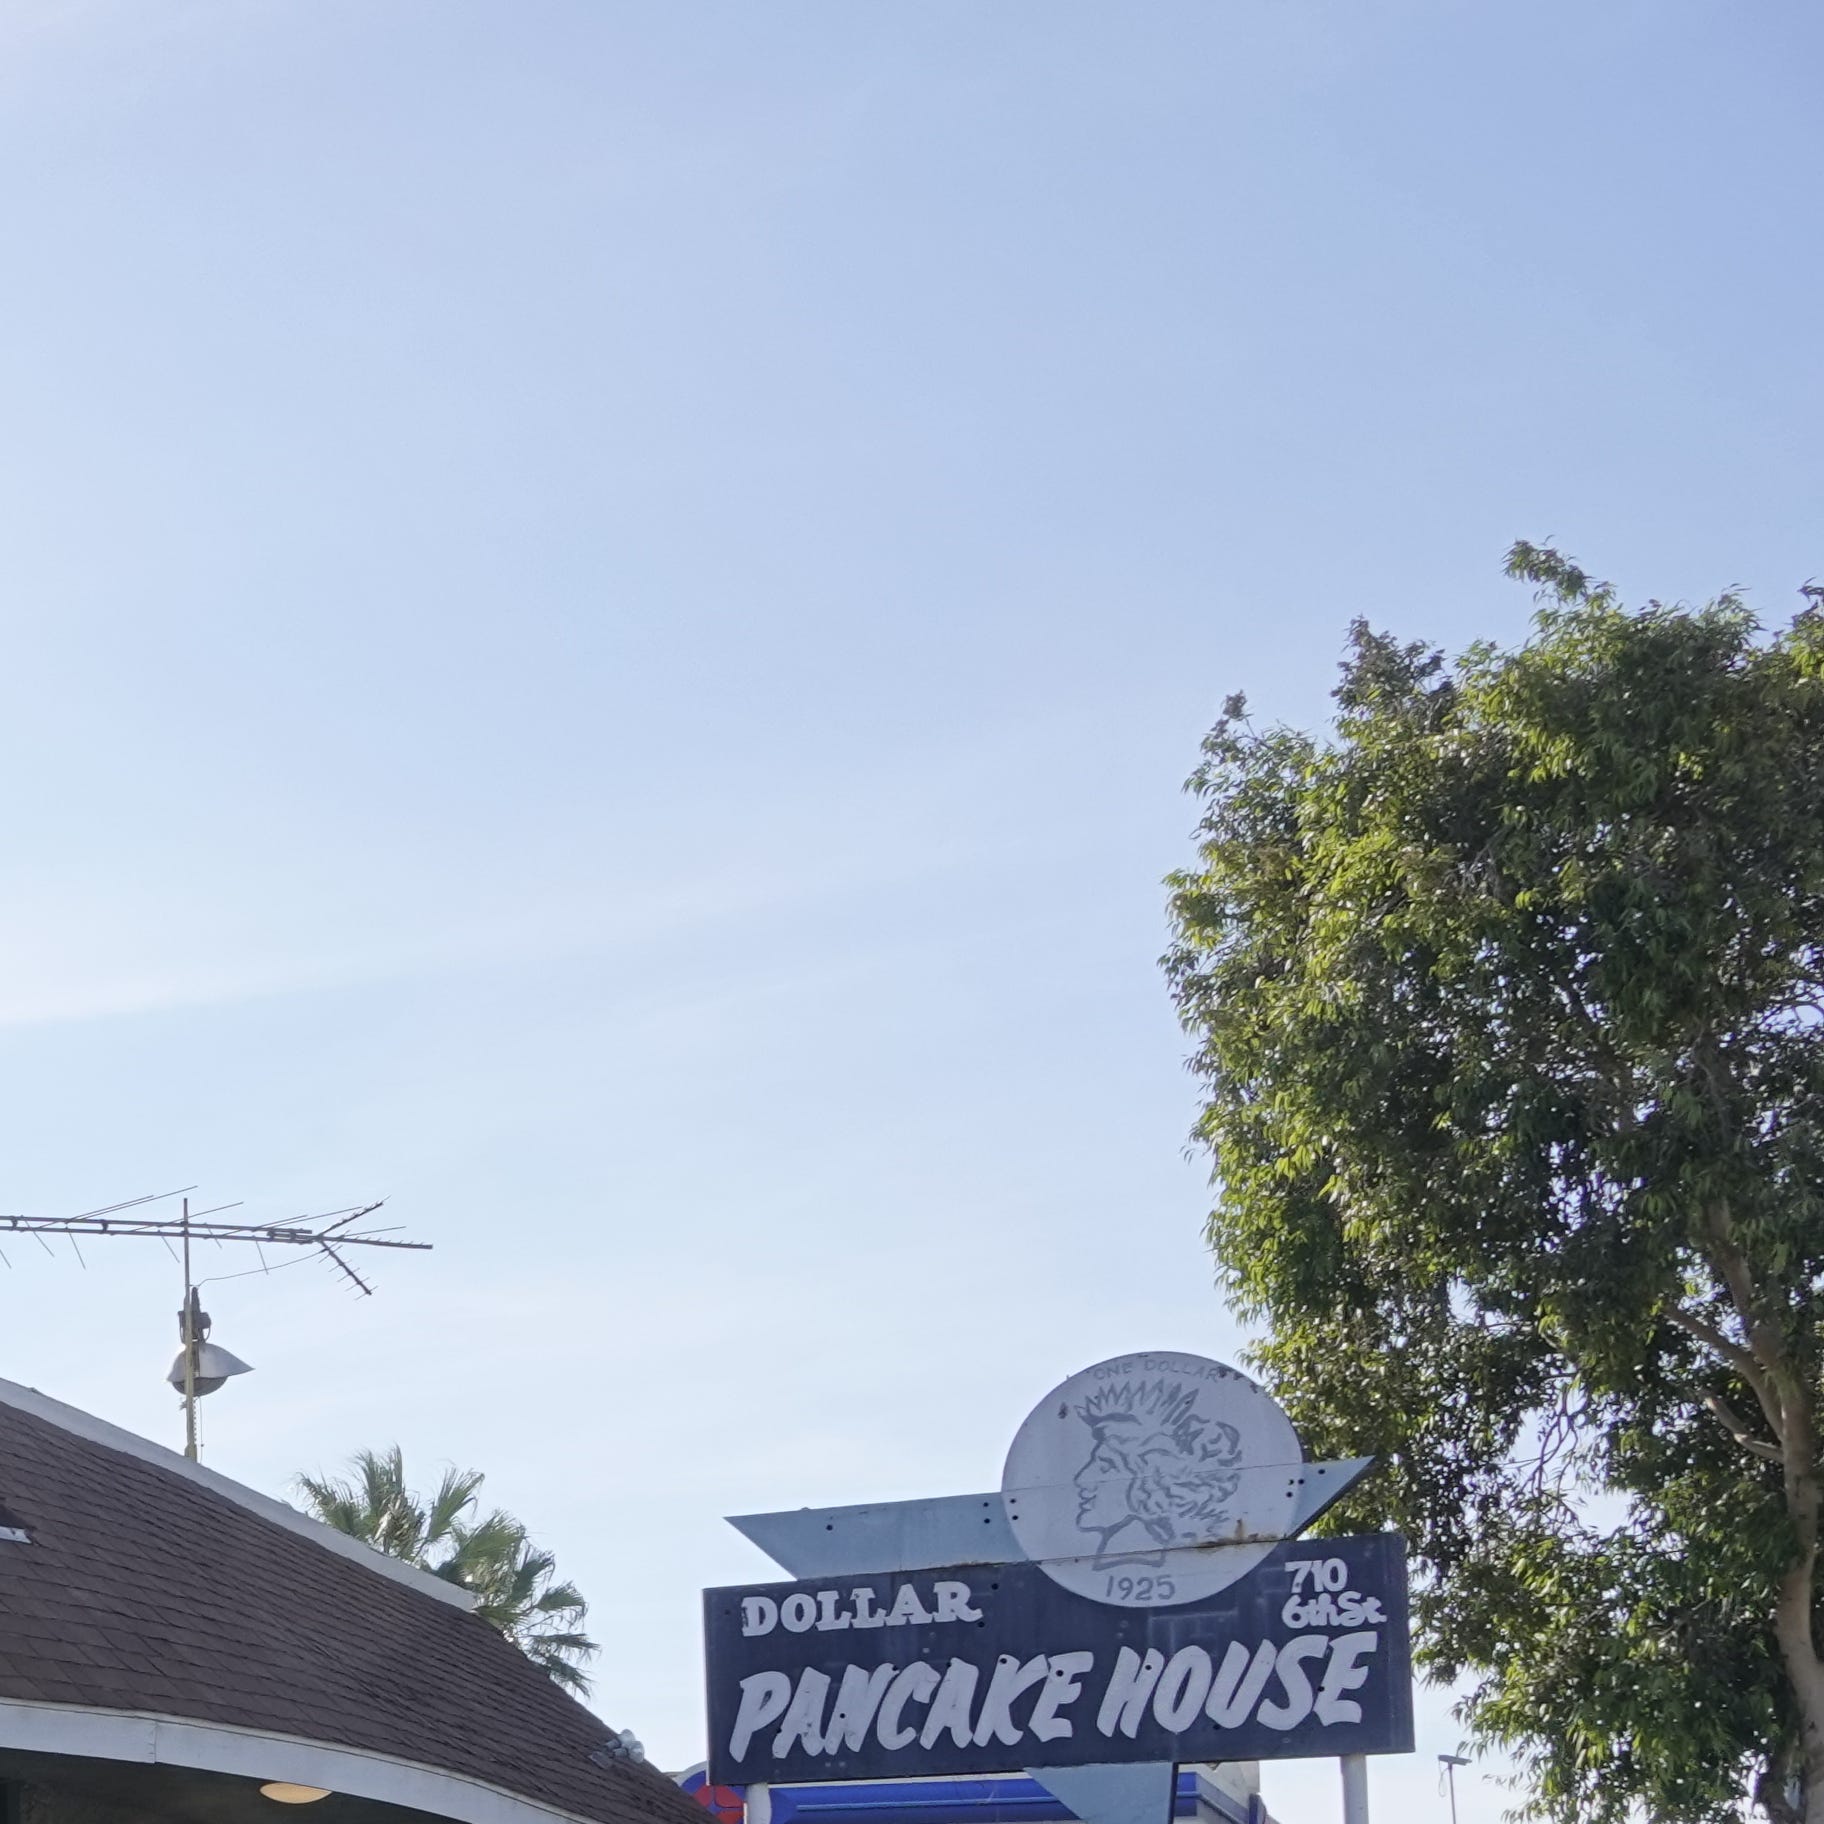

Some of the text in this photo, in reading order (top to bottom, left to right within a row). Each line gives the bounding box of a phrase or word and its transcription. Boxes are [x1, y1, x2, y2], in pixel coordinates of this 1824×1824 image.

[1093, 1359, 1219, 1383] ONE DOLLAR
[1105, 1574, 1176, 1601] 1925
[1284, 1557, 1349, 1594] 710
[741, 1581, 984, 1637] DOLLAR
[729, 1631, 1378, 1763] PANCAKE HOUSE
